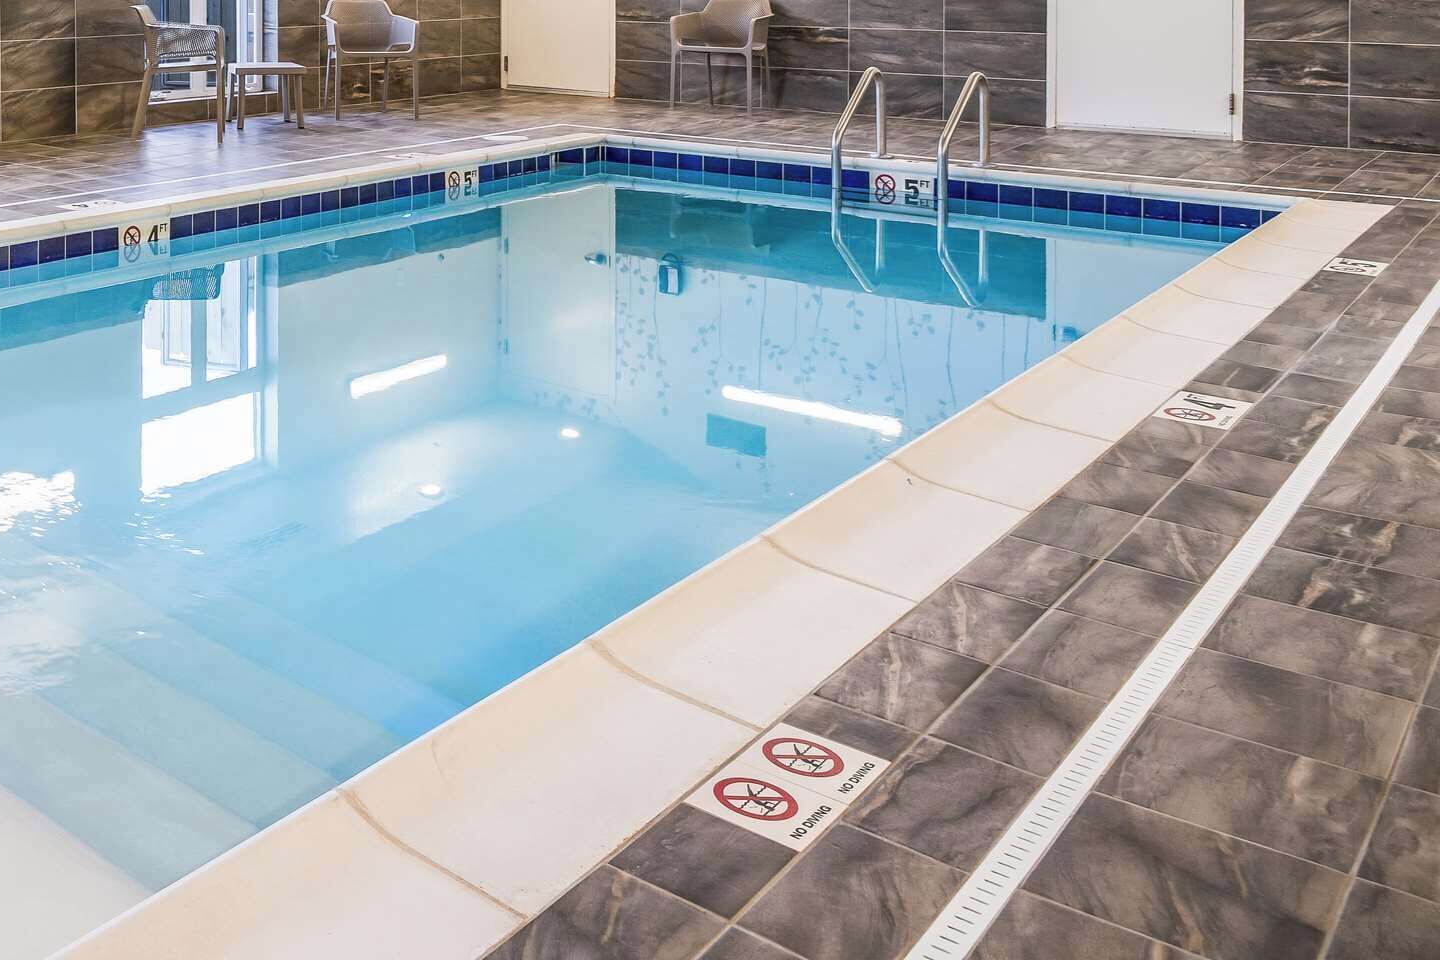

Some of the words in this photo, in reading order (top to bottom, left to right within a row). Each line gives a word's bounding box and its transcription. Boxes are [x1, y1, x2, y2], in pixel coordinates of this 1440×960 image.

[464, 171, 472, 187] 5
[904, 179, 919, 196] 5
[920, 180, 931, 189] FT
[147, 224, 160, 243] 4
[159, 223, 168, 233] FT
[838, 778, 854, 795] NO
[847, 761, 876, 785] DIVING
[790, 822, 809, 840] NO
[802, 805, 832, 831] DIVING
